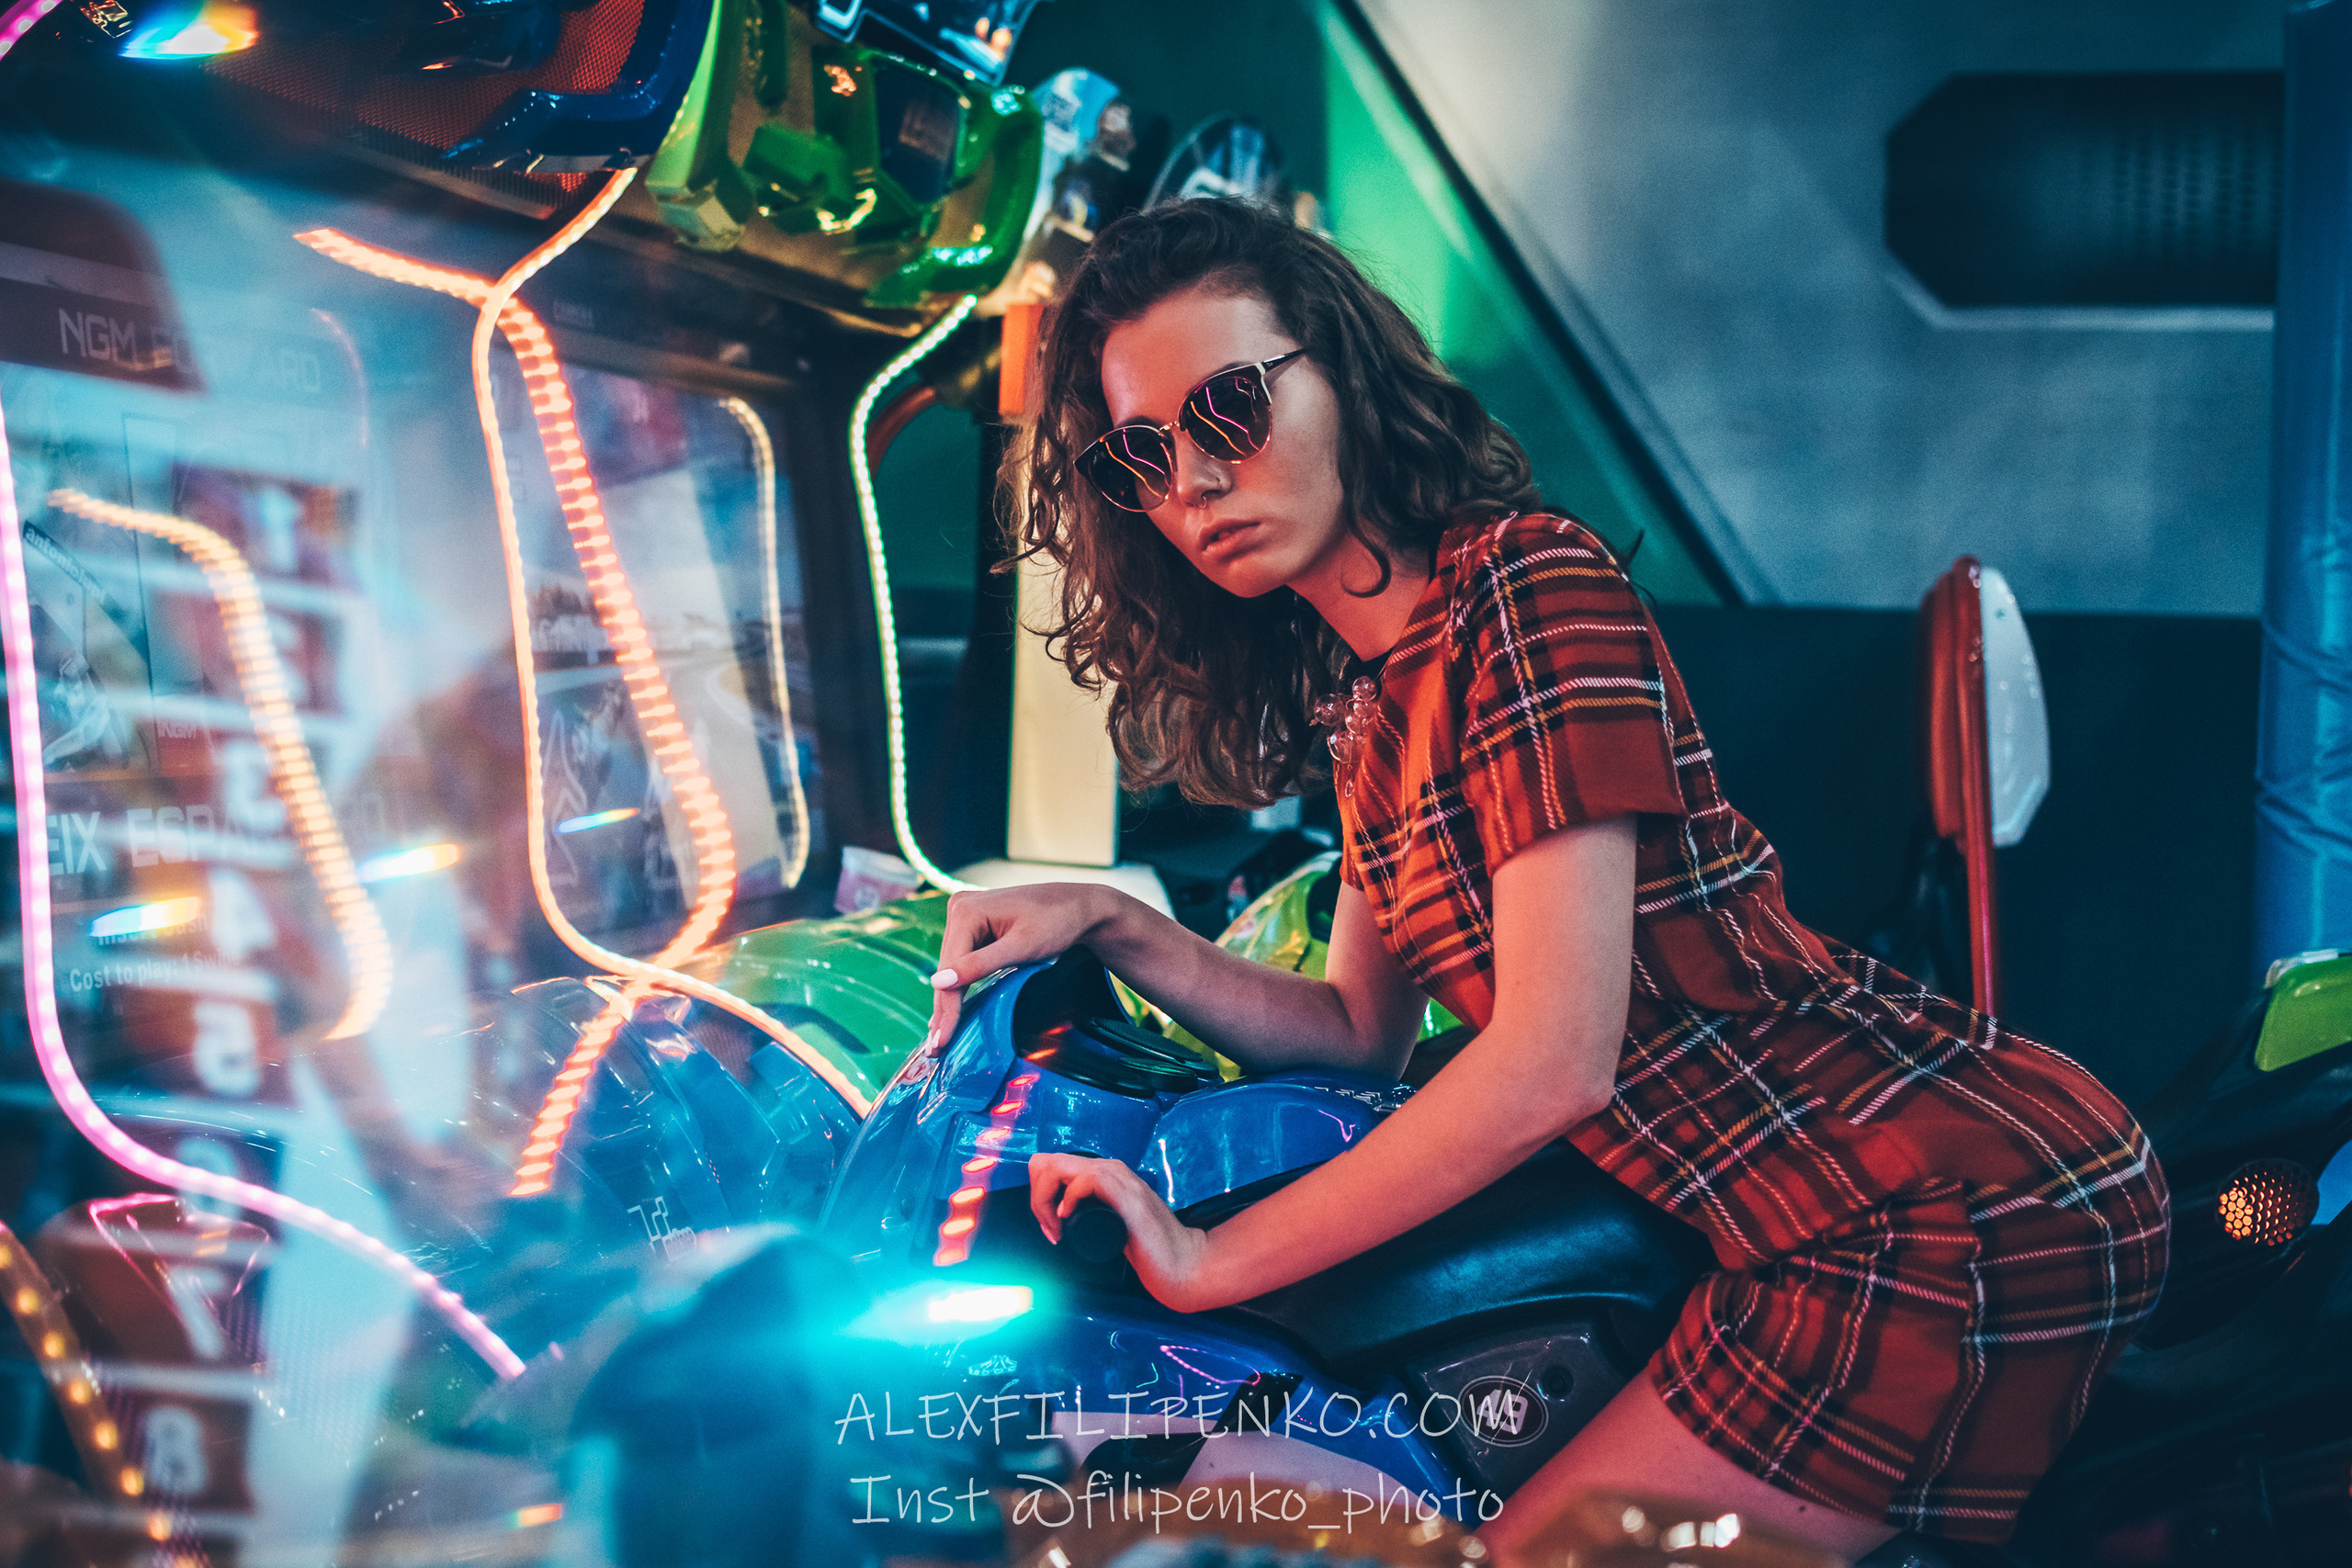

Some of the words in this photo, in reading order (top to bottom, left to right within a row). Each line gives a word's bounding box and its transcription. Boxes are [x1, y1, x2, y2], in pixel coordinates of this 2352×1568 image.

[58, 308, 137, 363] NGM
[151, 327, 322, 394] FOARD
[69, 964, 111, 992] Cost
[115, 963, 133, 985] to
